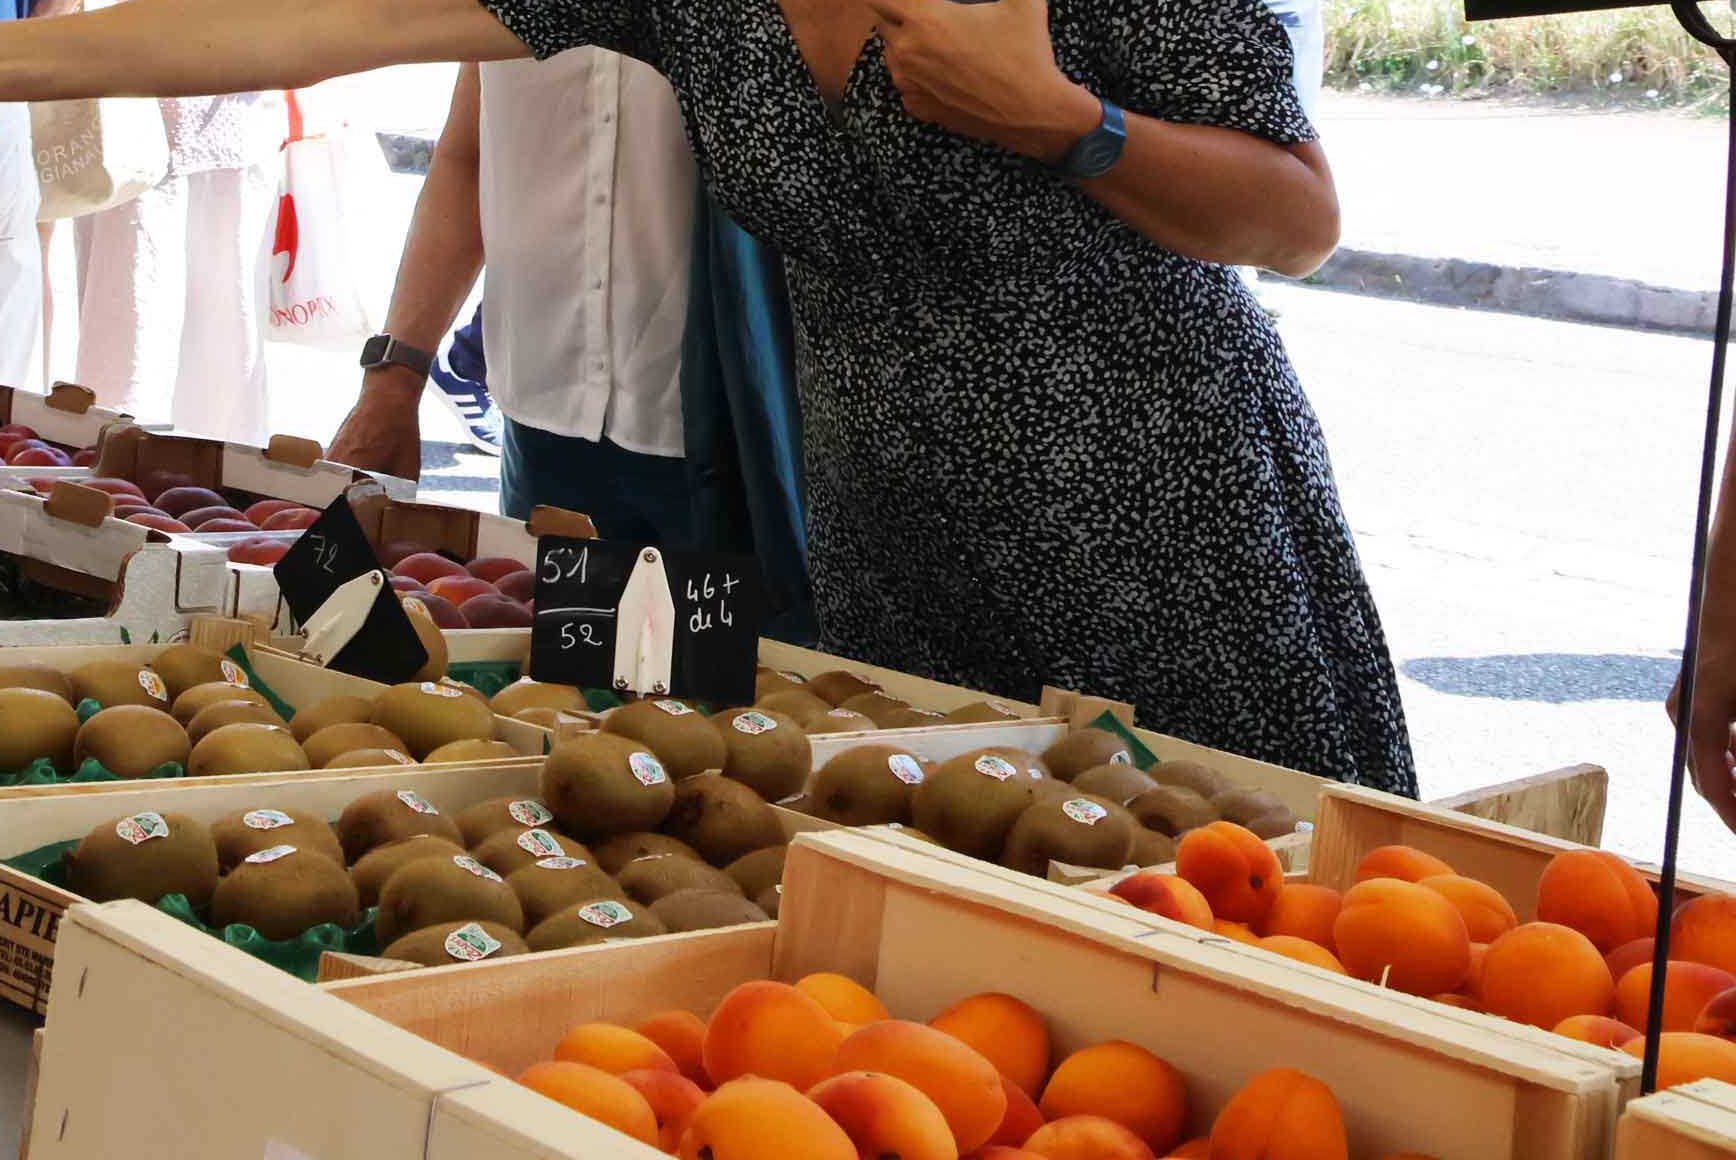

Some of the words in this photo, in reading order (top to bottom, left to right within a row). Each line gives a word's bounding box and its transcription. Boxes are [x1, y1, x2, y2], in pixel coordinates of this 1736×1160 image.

[311, 535, 338, 574] 72
[542, 546, 588, 584] 51
[561, 623, 603, 649] 52
